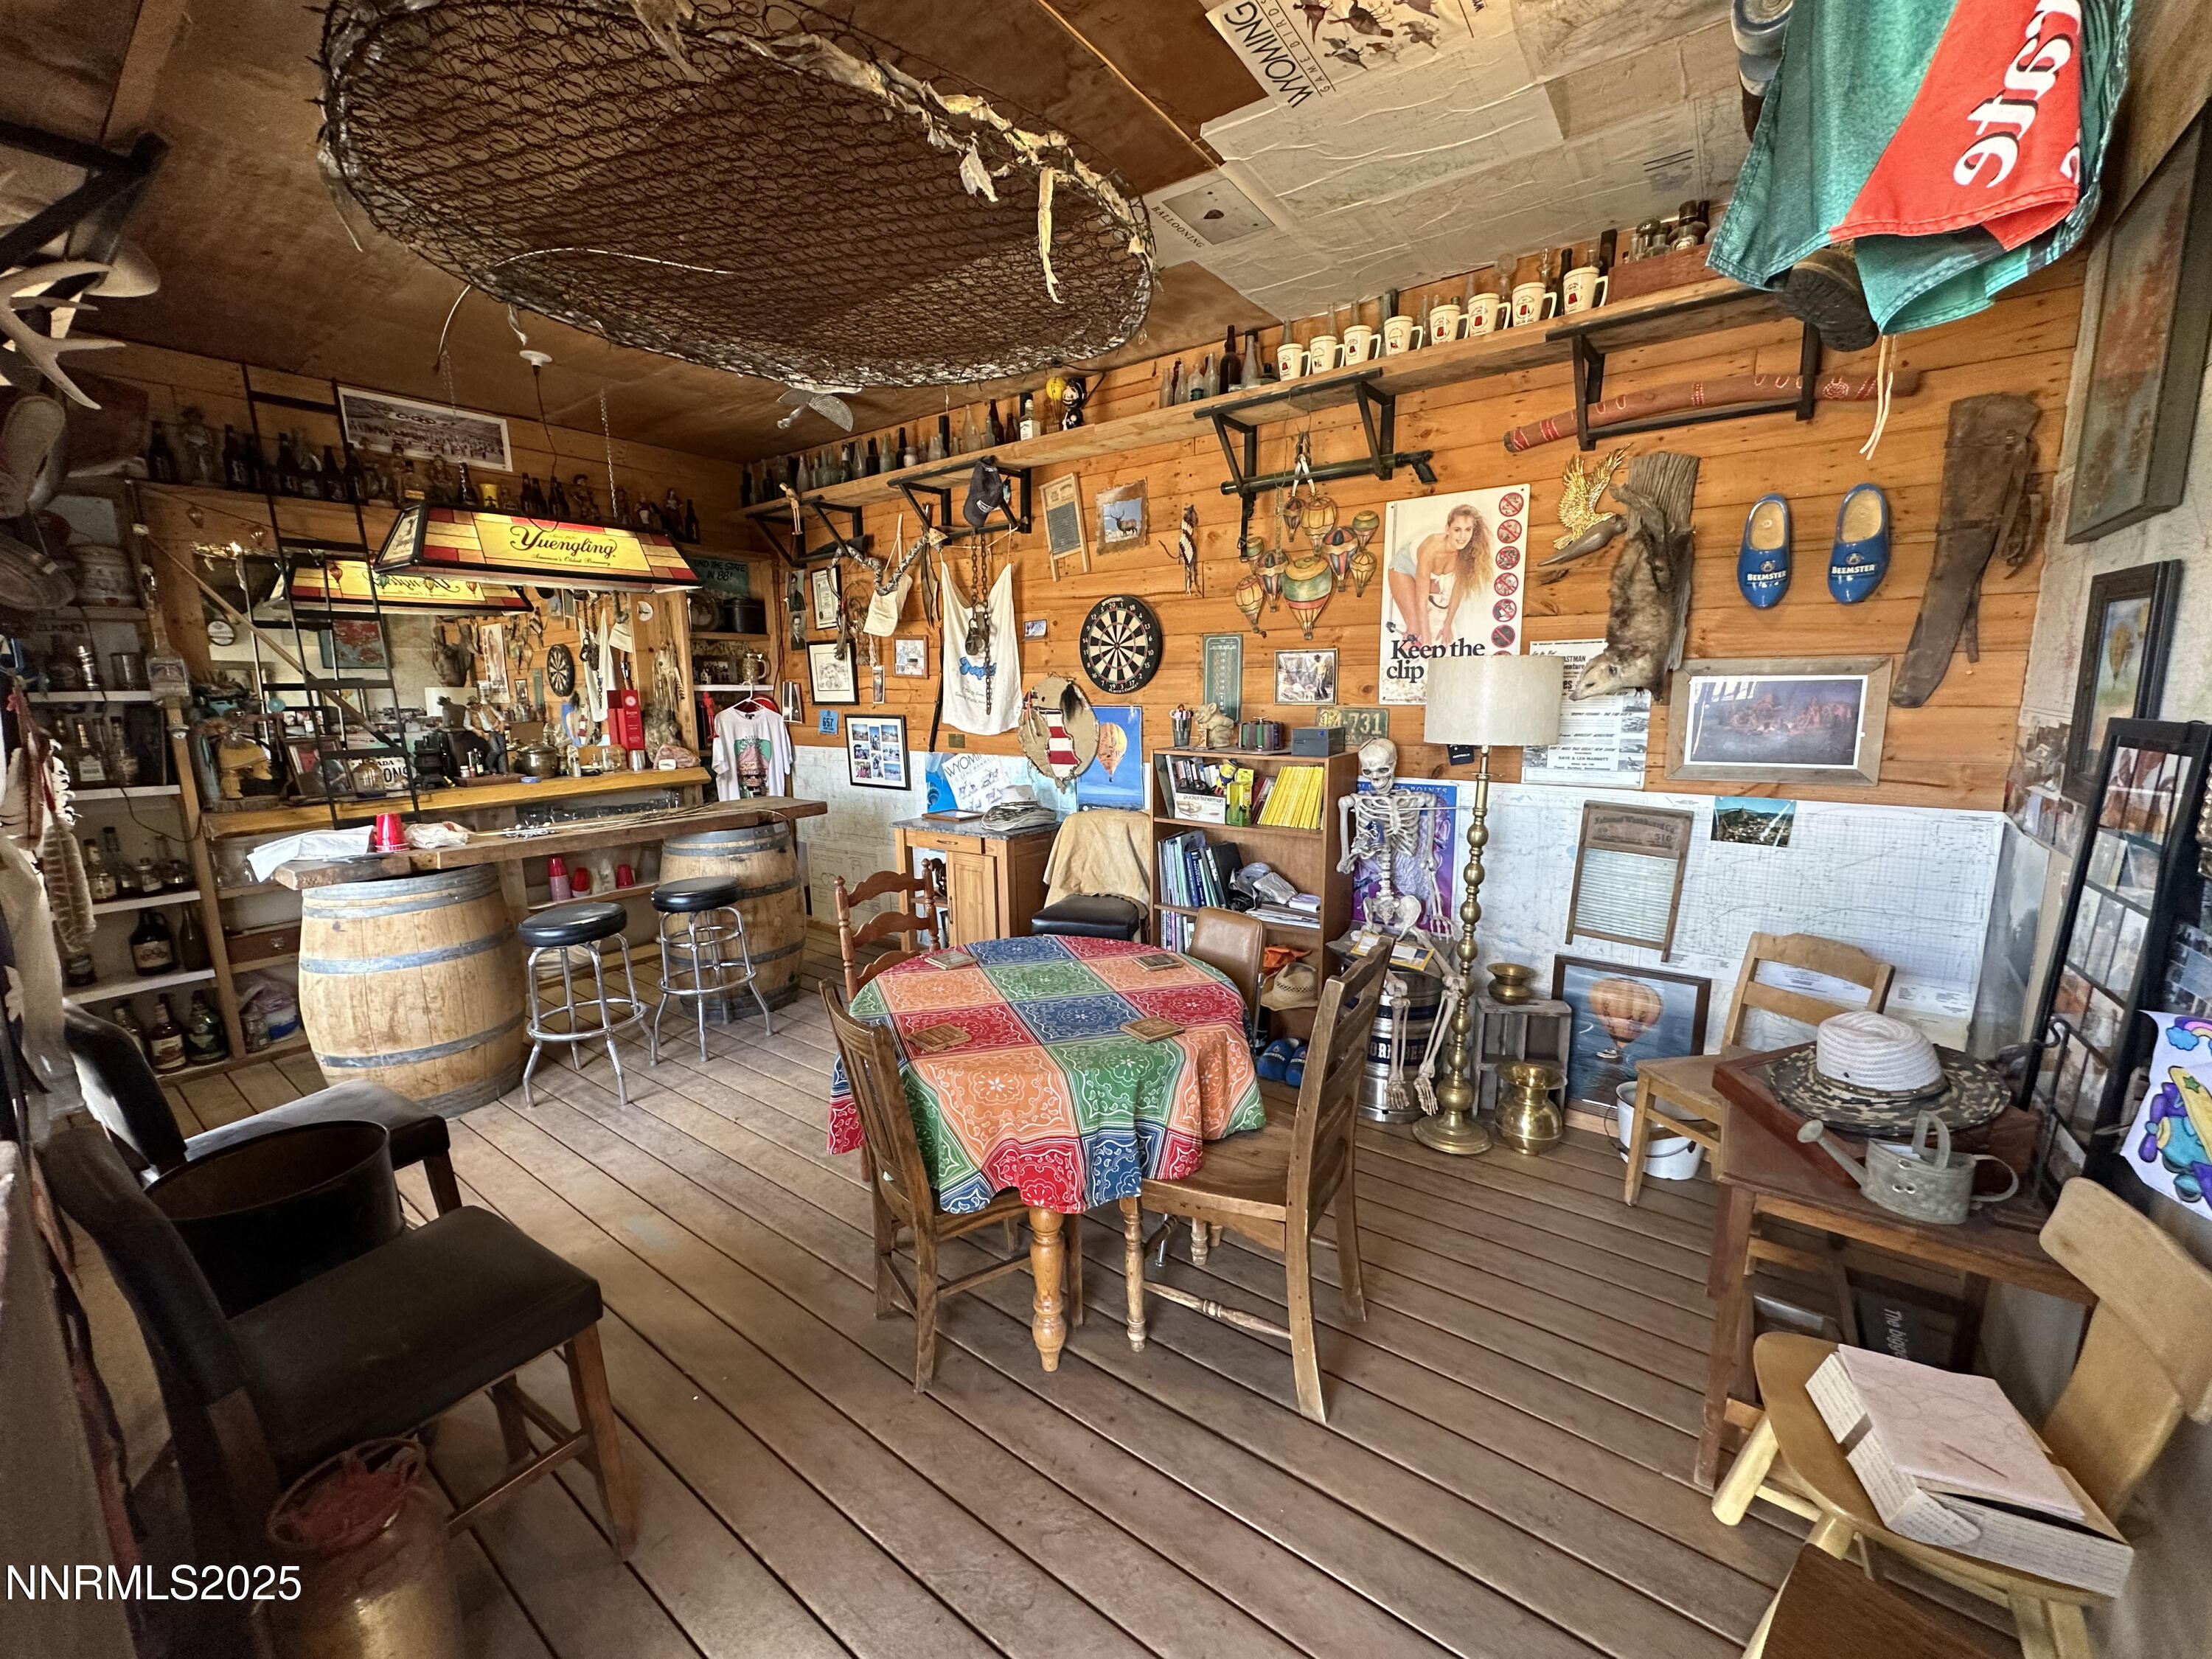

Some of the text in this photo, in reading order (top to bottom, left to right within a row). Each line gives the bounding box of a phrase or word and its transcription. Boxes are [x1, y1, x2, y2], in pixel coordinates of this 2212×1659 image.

[1224, 1, 1314, 108] WYOMING
[1299, 57, 1330, 93] GAME
[1151, 206, 1205, 248] BALLOONING
[509, 526, 617, 559] Yuengling
[1747, 571, 1787, 581] BEEMSTER
[1832, 564, 1875, 574] BEEMSTER
[1390, 637, 1485, 659] Keep the
[1386, 659, 1425, 684] clip
[823, 717, 833, 727] 657
[1884, 1308, 1908, 1359] The bigge
